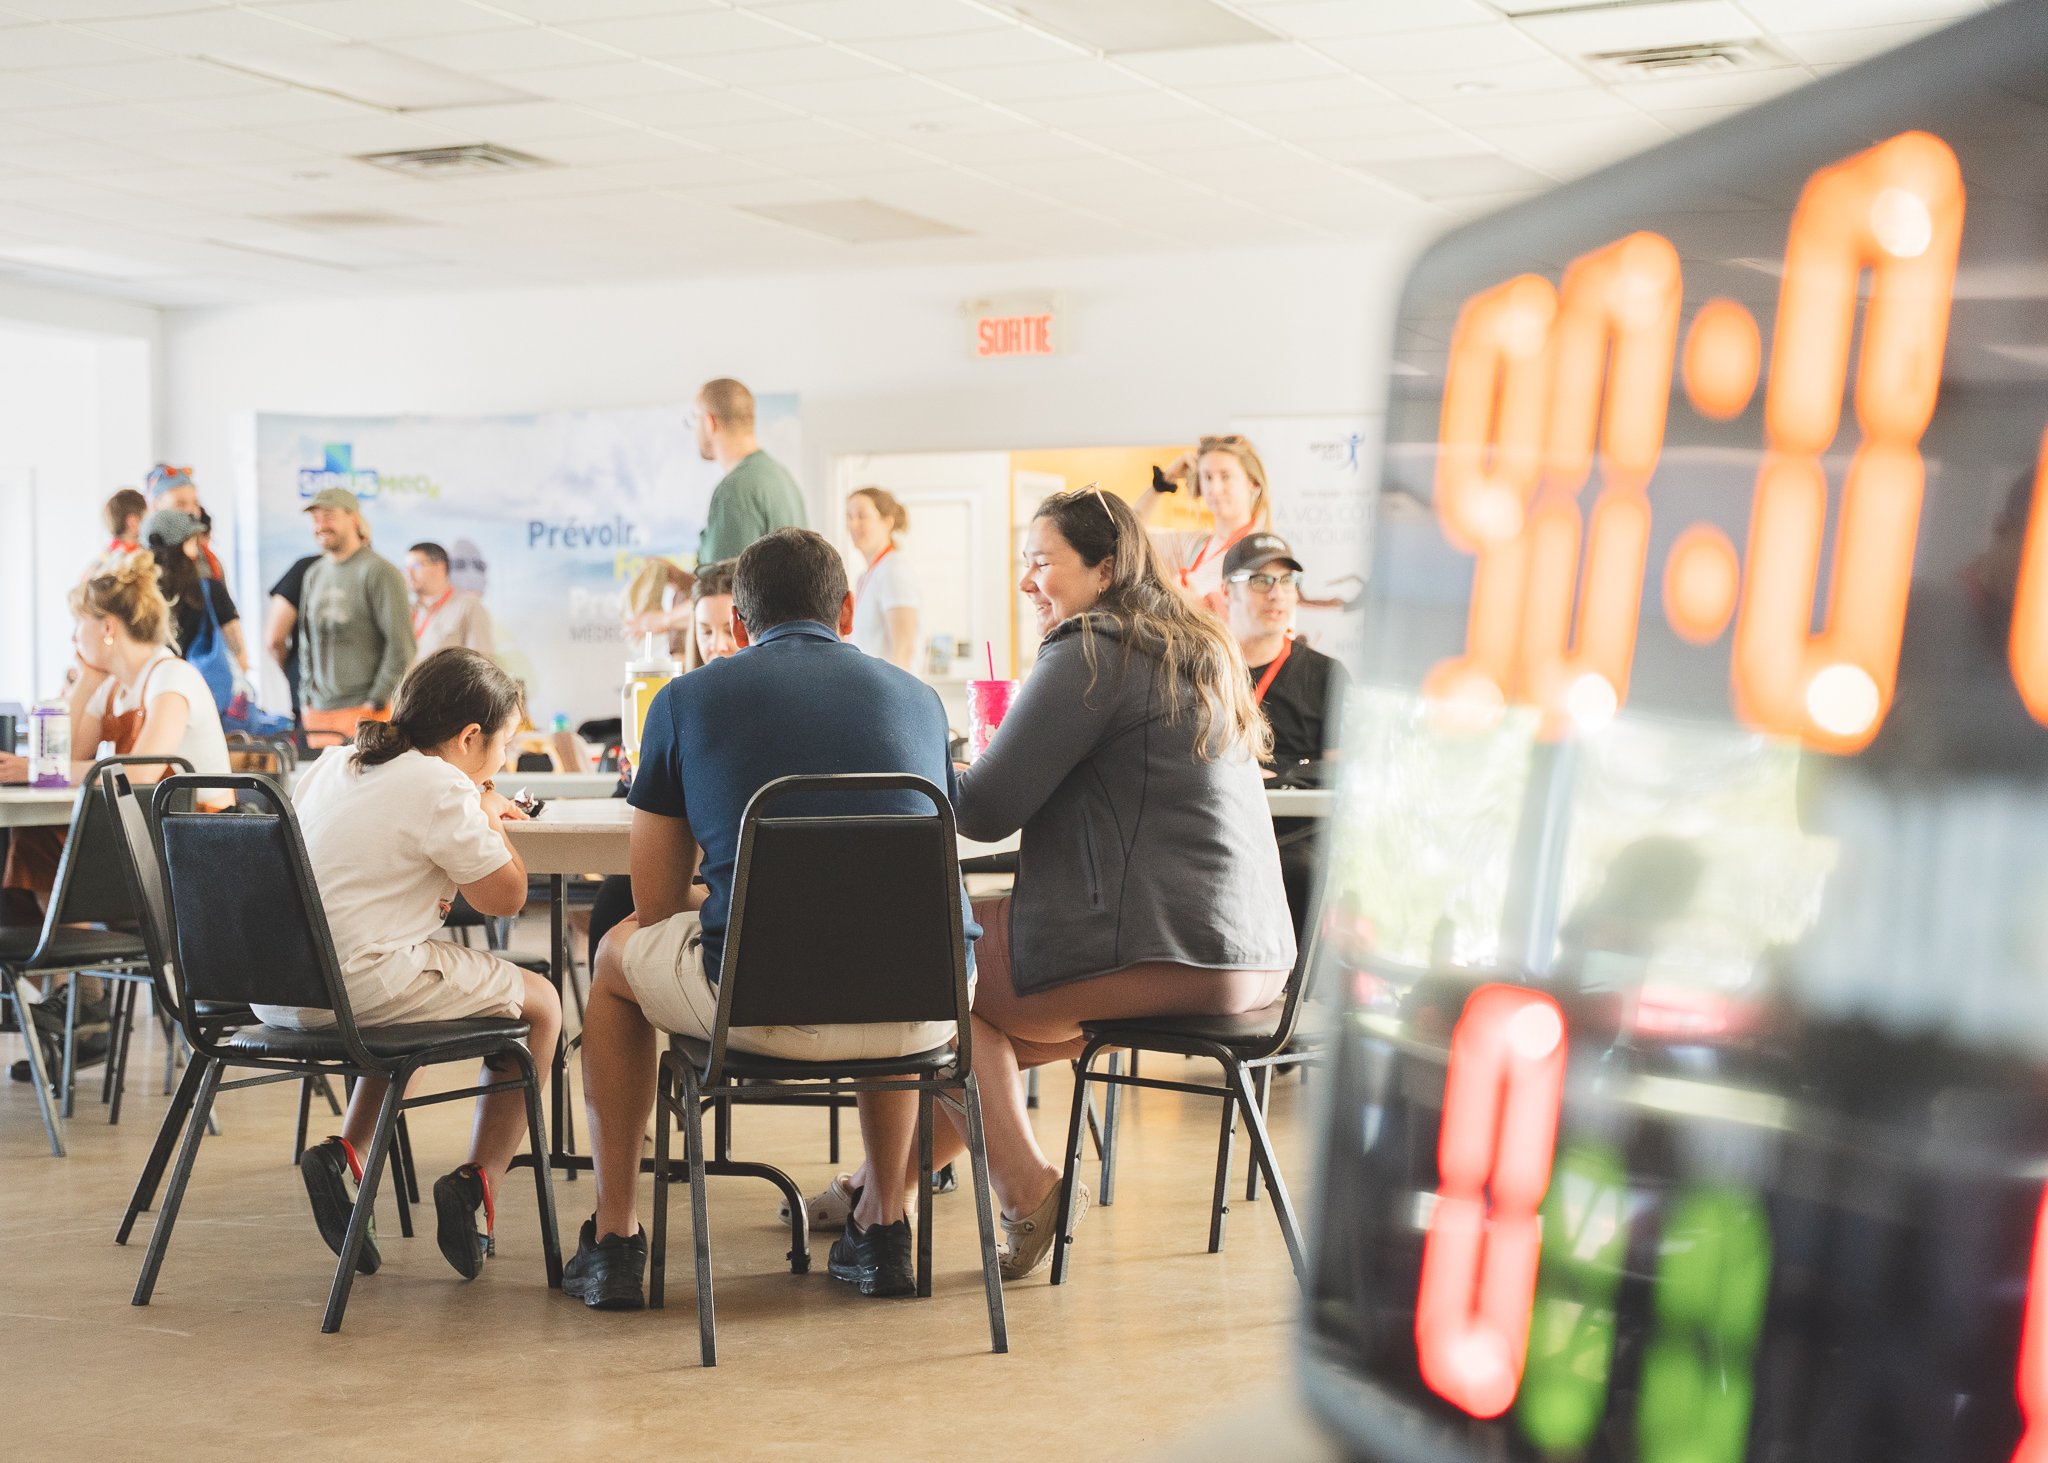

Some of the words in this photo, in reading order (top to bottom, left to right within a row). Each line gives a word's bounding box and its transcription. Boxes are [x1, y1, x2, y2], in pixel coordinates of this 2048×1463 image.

[977, 314, 1054, 356] SORTIE
[1339, 501, 1376, 523] CÔT
[528, 514, 640, 548] Prévoir.
